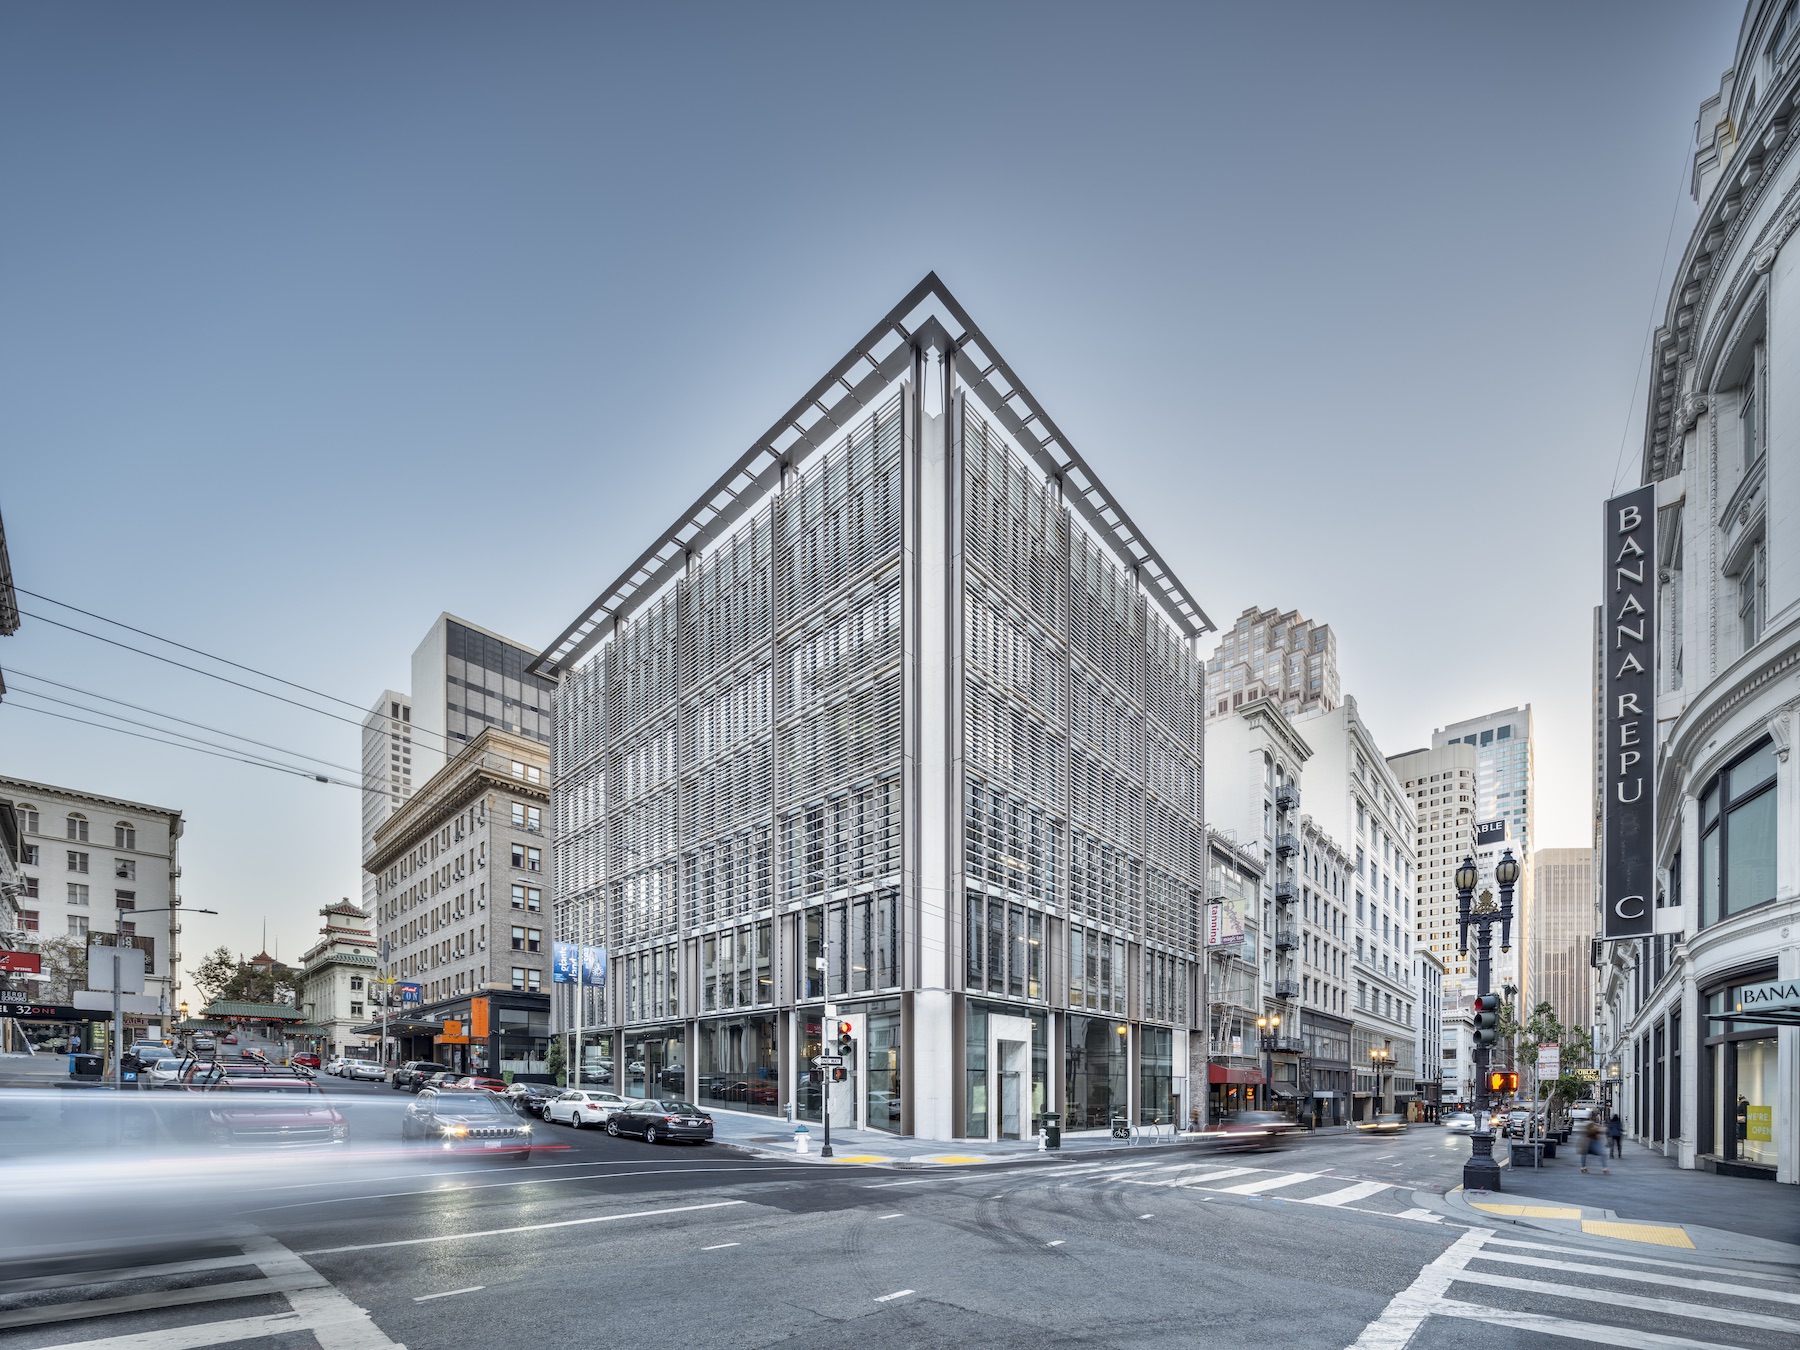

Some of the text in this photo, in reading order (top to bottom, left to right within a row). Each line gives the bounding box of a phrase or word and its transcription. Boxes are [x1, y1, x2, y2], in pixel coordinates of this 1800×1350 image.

[1615, 505, 1646, 680] BANANA
[1209, 905, 1218, 944] tanning
[1744, 984, 1800, 1004] BANA
[1752, 1126, 1772, 1135] OPEN
